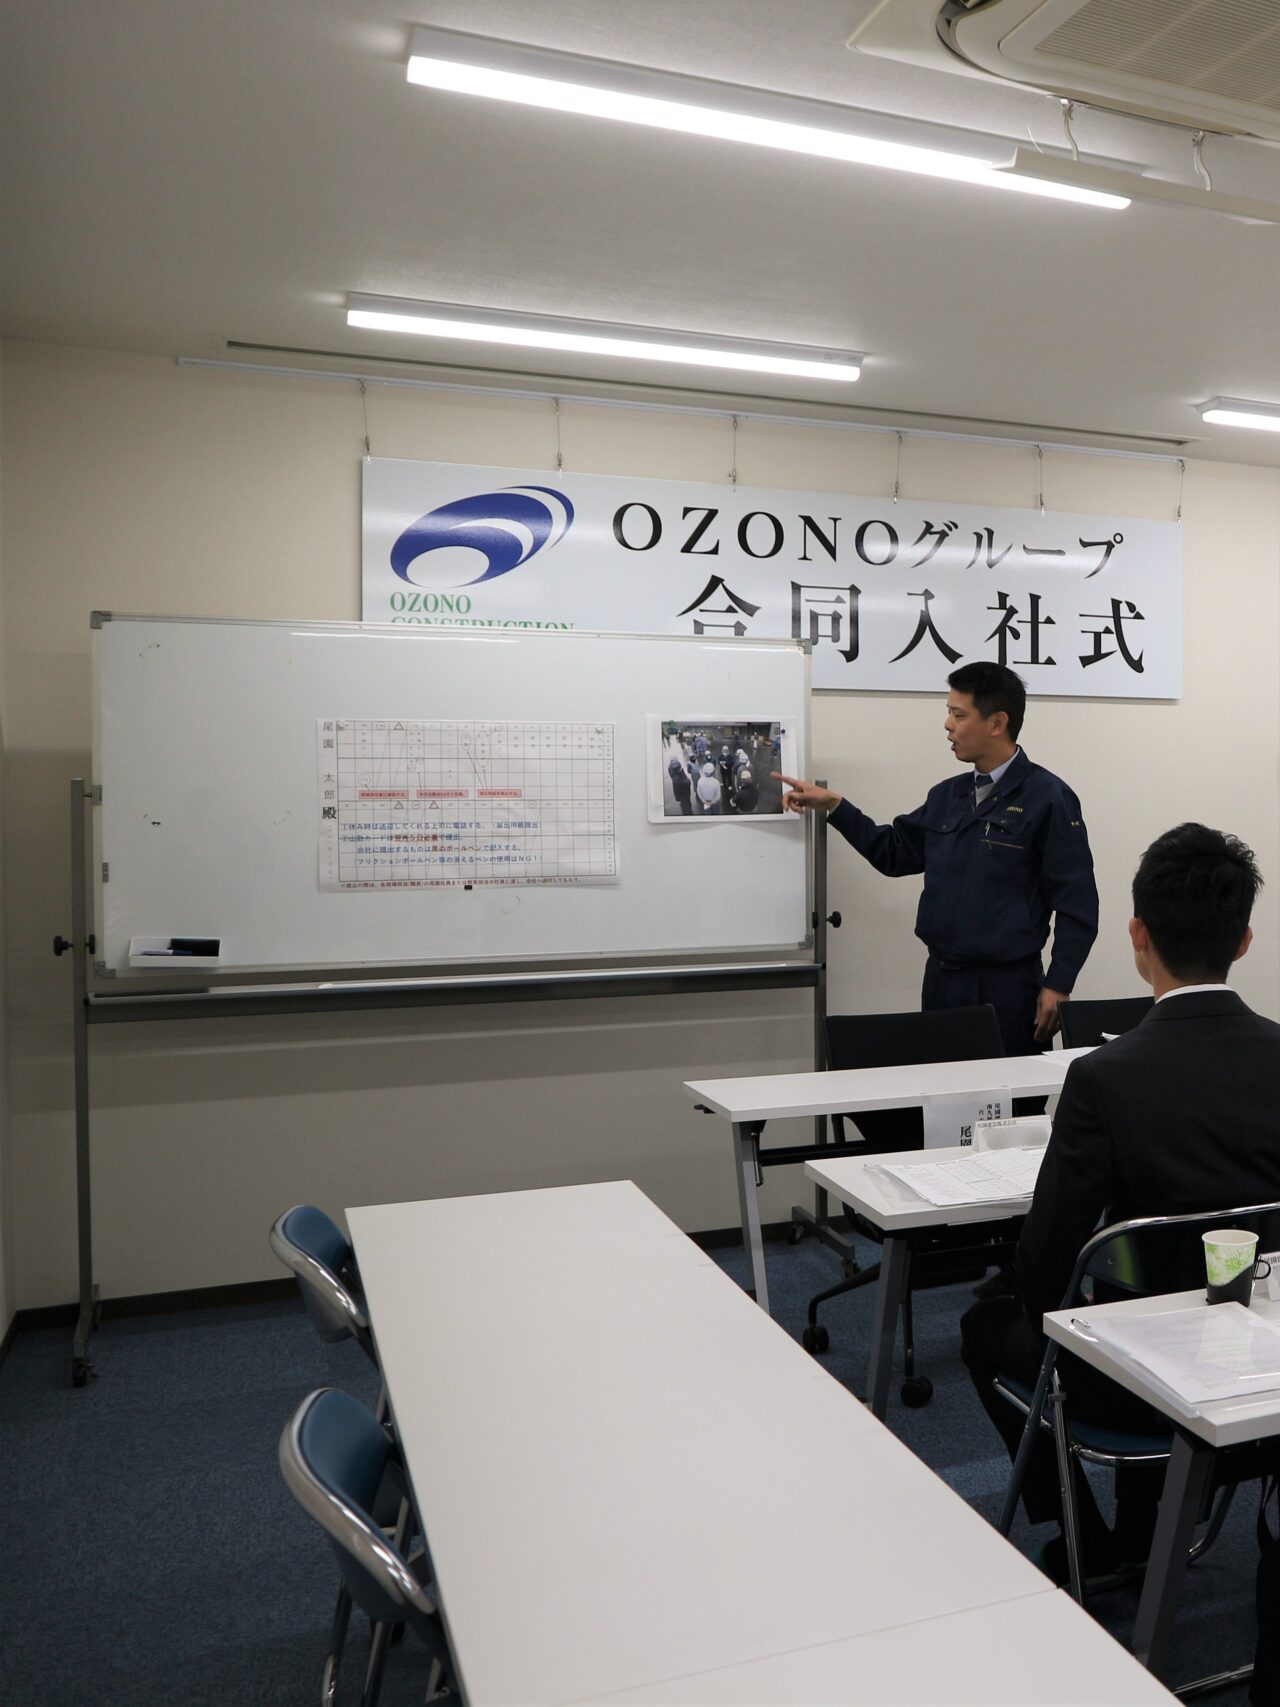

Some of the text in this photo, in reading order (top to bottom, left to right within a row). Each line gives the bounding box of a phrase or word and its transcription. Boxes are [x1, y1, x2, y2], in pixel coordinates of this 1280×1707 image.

[612, 502, 1123, 578] OZONOグループ
[390, 592, 471, 614] OZONO
[677, 573, 1147, 674] 合同入社式
[322, 806, 337, 820] 殿
